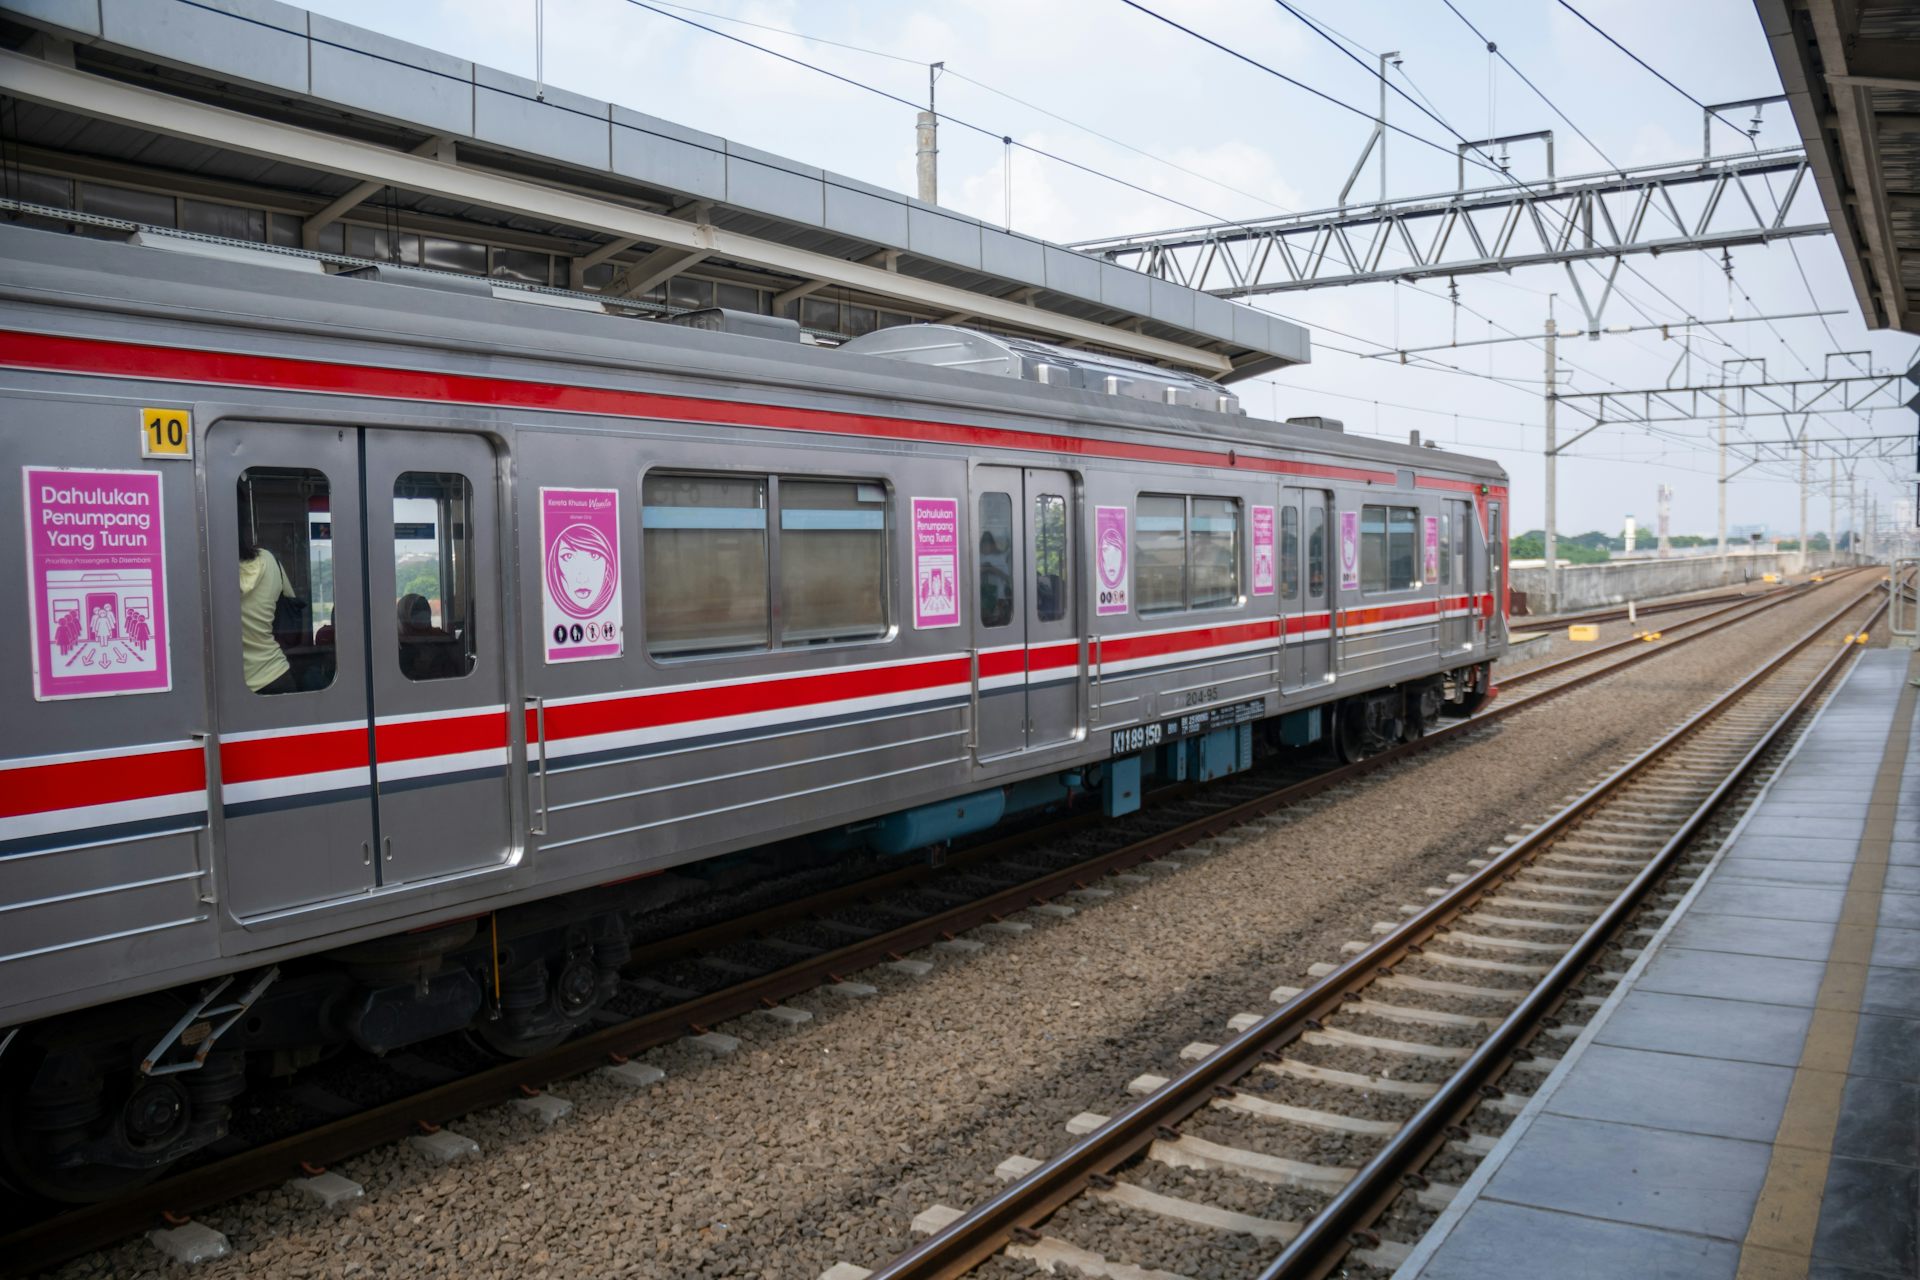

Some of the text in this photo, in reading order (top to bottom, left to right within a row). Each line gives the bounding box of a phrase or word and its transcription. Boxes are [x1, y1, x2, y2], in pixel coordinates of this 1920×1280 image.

[150, 418, 183, 446] 10
[41, 486, 149, 505] Dahulukan
[42, 509, 150, 530] Penumpang
[916, 508, 953, 519] Dahulukan
[917, 520, 953, 533] Penumpang
[47, 530, 147, 550] Yang Turun
[918, 533, 952, 545] Yang Turun
